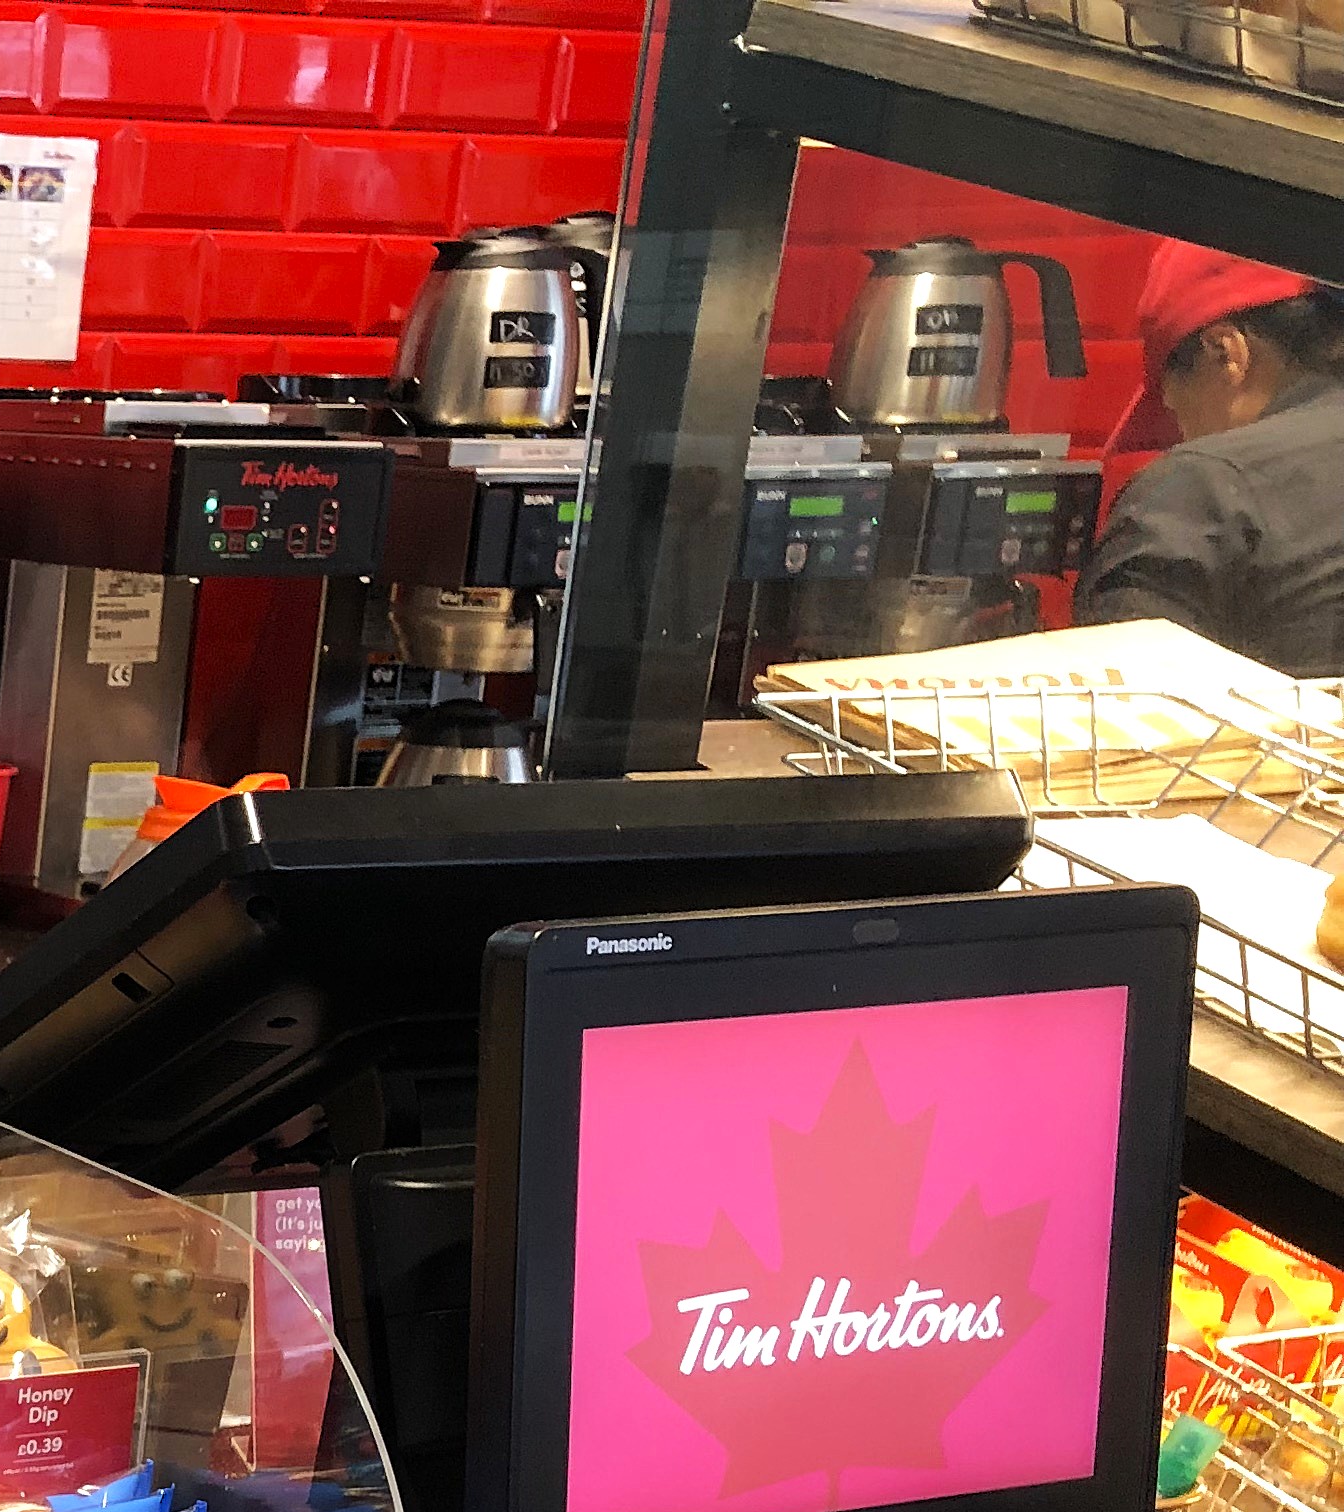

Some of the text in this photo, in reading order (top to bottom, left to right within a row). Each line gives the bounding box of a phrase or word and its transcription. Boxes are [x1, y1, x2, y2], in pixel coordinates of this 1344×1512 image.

[241, 460, 272, 487] Tim
[586, 932, 673, 956] Panasonic
[308, 1216, 323, 1235] ju
[677, 1287, 780, 1376] Tim
[17, 1386, 74, 1406] Honey
[28, 1405, 59, 1427] Dip
[17, 1436, 63, 1456] £0.39
